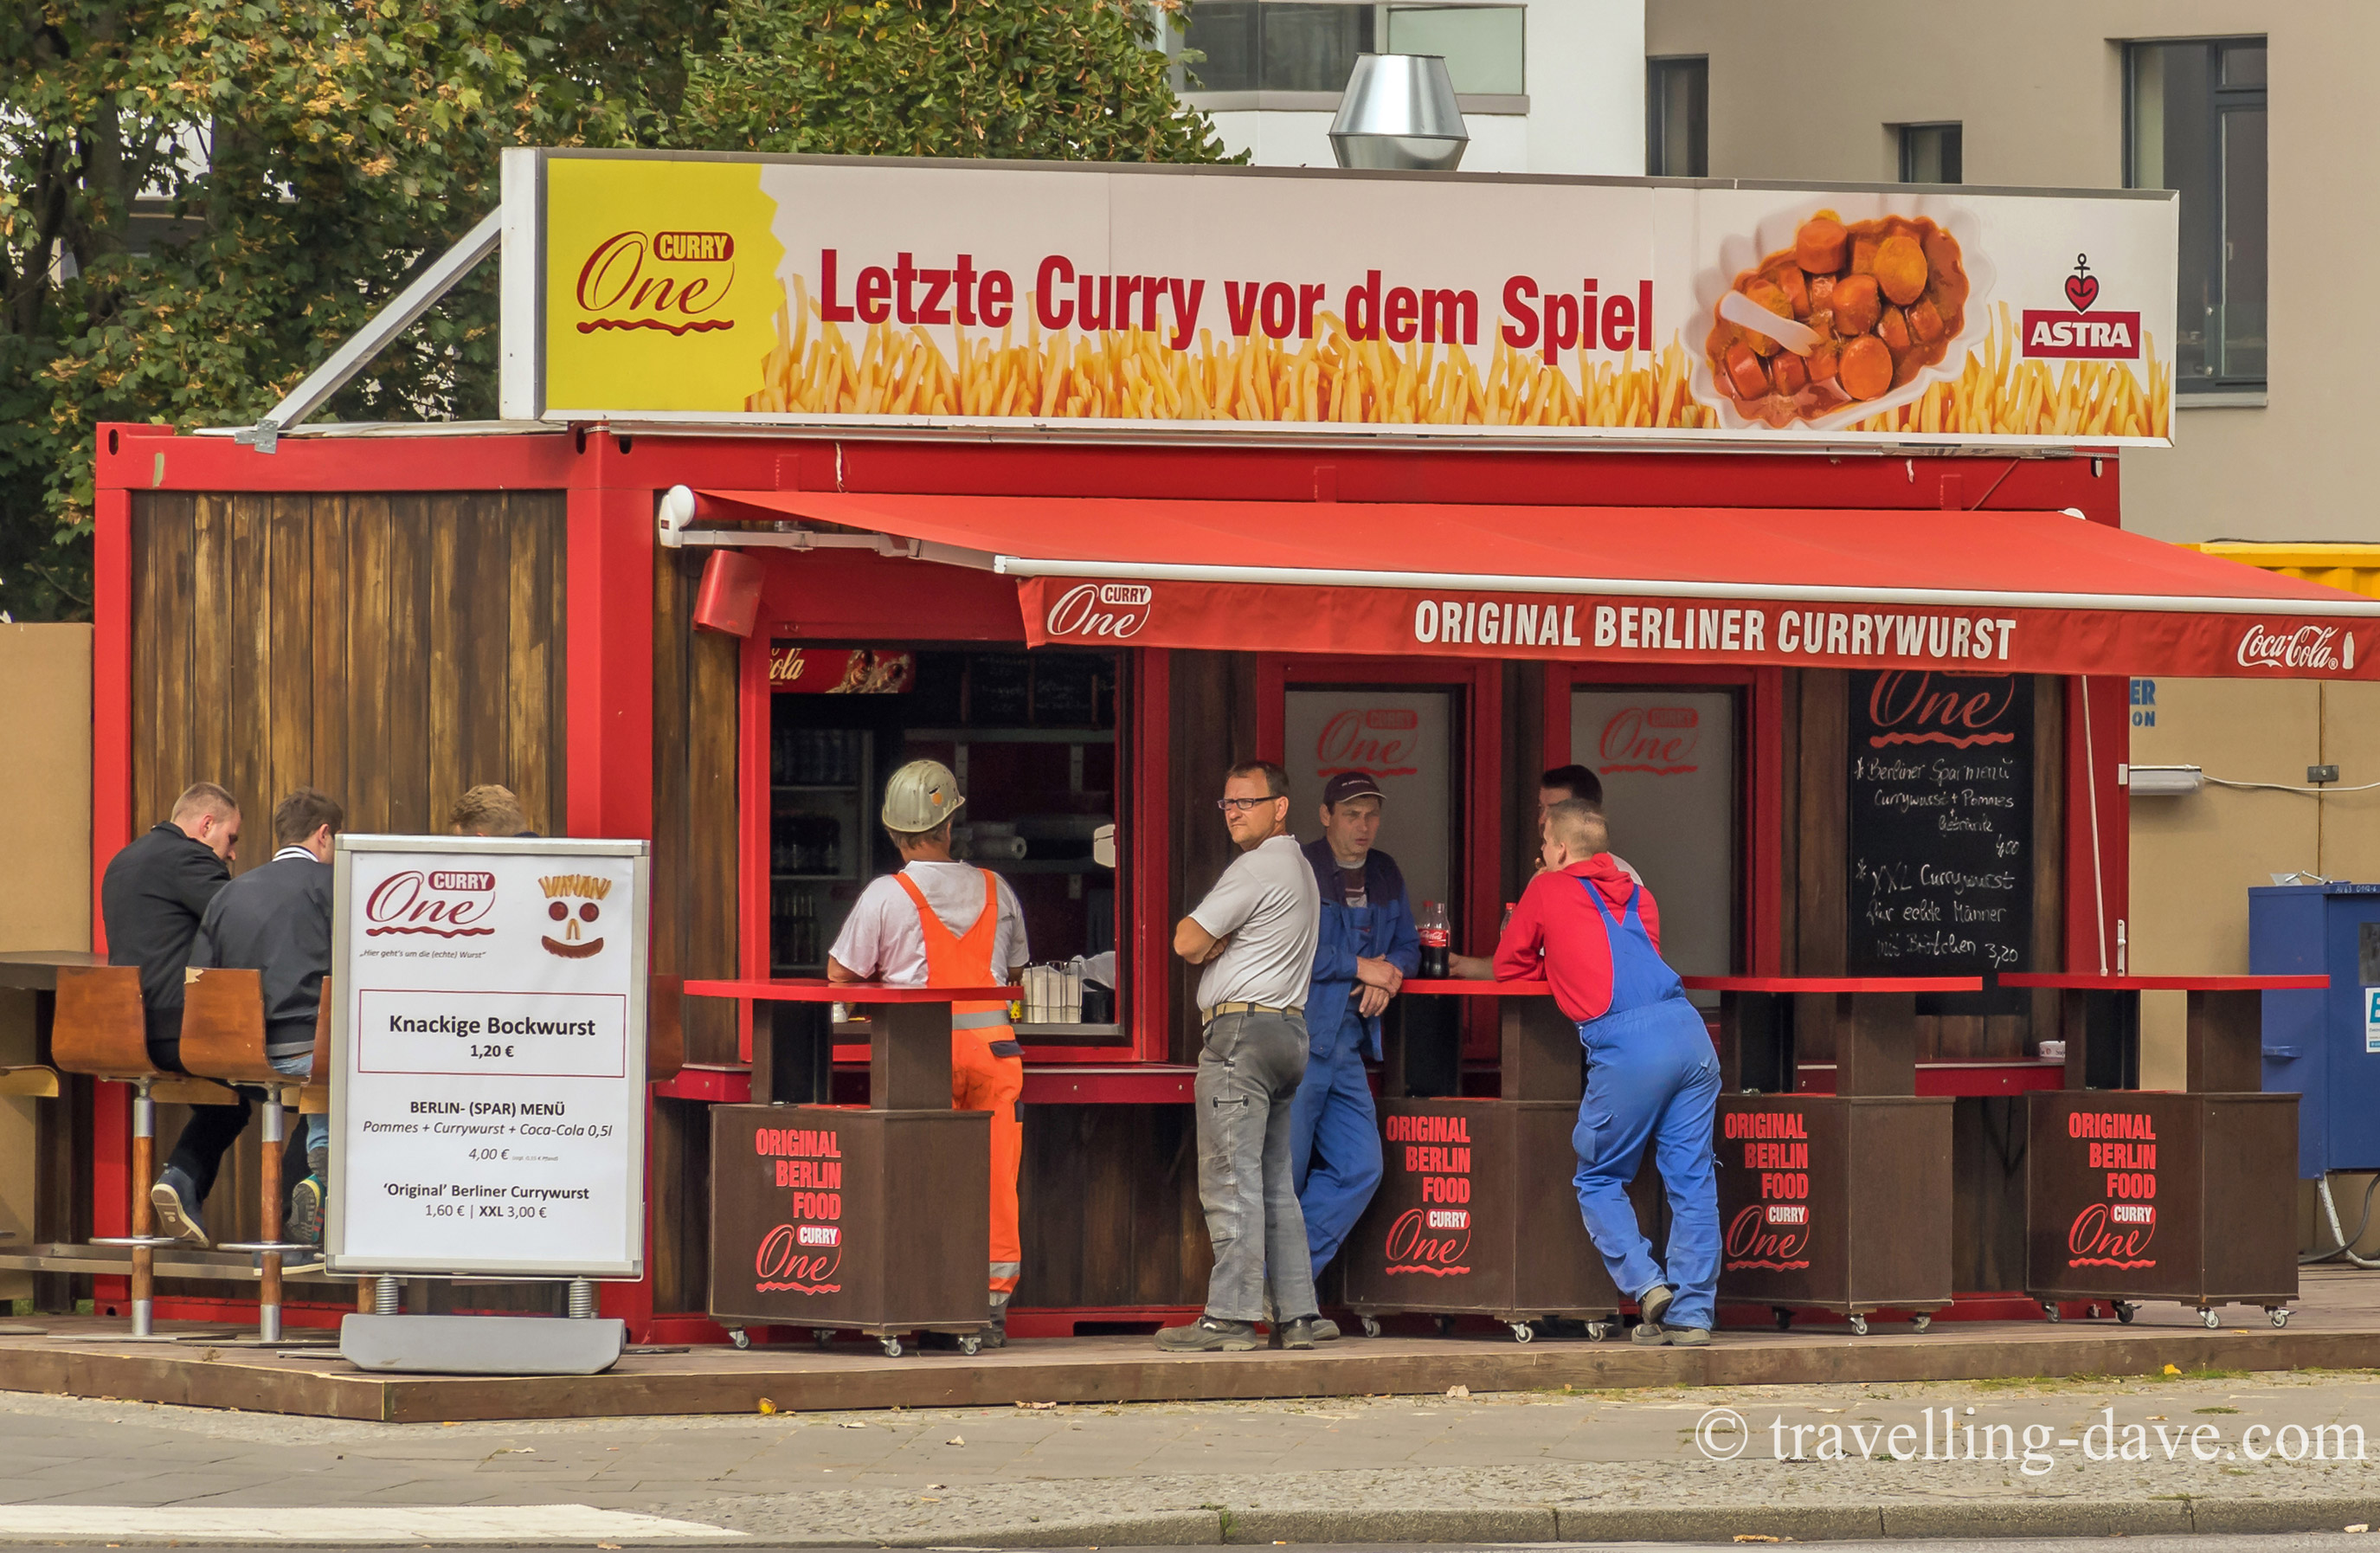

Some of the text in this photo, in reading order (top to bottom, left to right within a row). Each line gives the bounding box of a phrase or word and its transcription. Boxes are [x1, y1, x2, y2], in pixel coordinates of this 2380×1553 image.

[659, 233, 729, 261] CURRY
[576, 230, 735, 315] One
[820, 248, 1654, 366] Letzte Curry vor dem Spiel
[2029, 320, 2132, 348] ASTRA
[1104, 585, 1148, 604] CURRY
[1046, 583, 1151, 639] One
[1414, 599, 2017, 661] ORIGINAL BERLINER CURRYWURST
[769, 648, 806, 680] ola
[1869, 670, 2015, 728] One
[1317, 709, 1418, 764] One
[1599, 707, 1700, 763] One
[433, 872, 490, 890] CURRY
[365, 869, 497, 925] One
[389, 1015, 596, 1038] Knackige Bockwurst
[470, 1044, 515, 1060] 1,20 €
[410, 1100, 566, 1118] BERLIN- (SPAR) MENÜ
[363, 1120, 613, 1138] Pommes + Currywurst + Coca-Cola 0,5l
[1386, 1115, 1471, 1144] ORIGINAL
[1724, 1112, 1808, 1139] ORIGINAL
[2068, 1112, 2157, 1140] ORIGINAL
[468, 1148, 498, 1162] 4,00
[500, 1149, 510, 1160] €
[756, 1127, 841, 1157] ORIGINAL
[1744, 1143, 1809, 1169] BERLIN
[2089, 1142, 2157, 1170] BERLIN
[1405, 1145, 1470, 1173] BERLIN
[775, 1160, 842, 1189] BERLIN
[1761, 1172, 1809, 1199] FOOD
[2107, 1172, 2157, 1199] FOOD
[451, 1184, 507, 1198] Berliner
[511, 1186, 589, 1201] Currywurst
[1422, 1176, 1470, 1203] FOOD
[425, 1204, 453, 1219] 1,60
[457, 1205, 466, 1217] €
[479, 1206, 504, 1217] XXL
[507, 1206, 537, 1220] 3,00
[538, 1207, 548, 1218] €
[793, 1191, 841, 1221] FOOD
[1429, 1210, 1468, 1228] CURRY
[1768, 1206, 1805, 1223] CURRY
[2113, 1205, 2153, 1223] CURRY
[800, 1227, 839, 1245] CURRY
[1386, 1208, 1471, 1264] One
[1726, 1204, 1811, 1259] One
[2068, 1202, 2157, 1257] One
[756, 1223, 842, 1281] One
